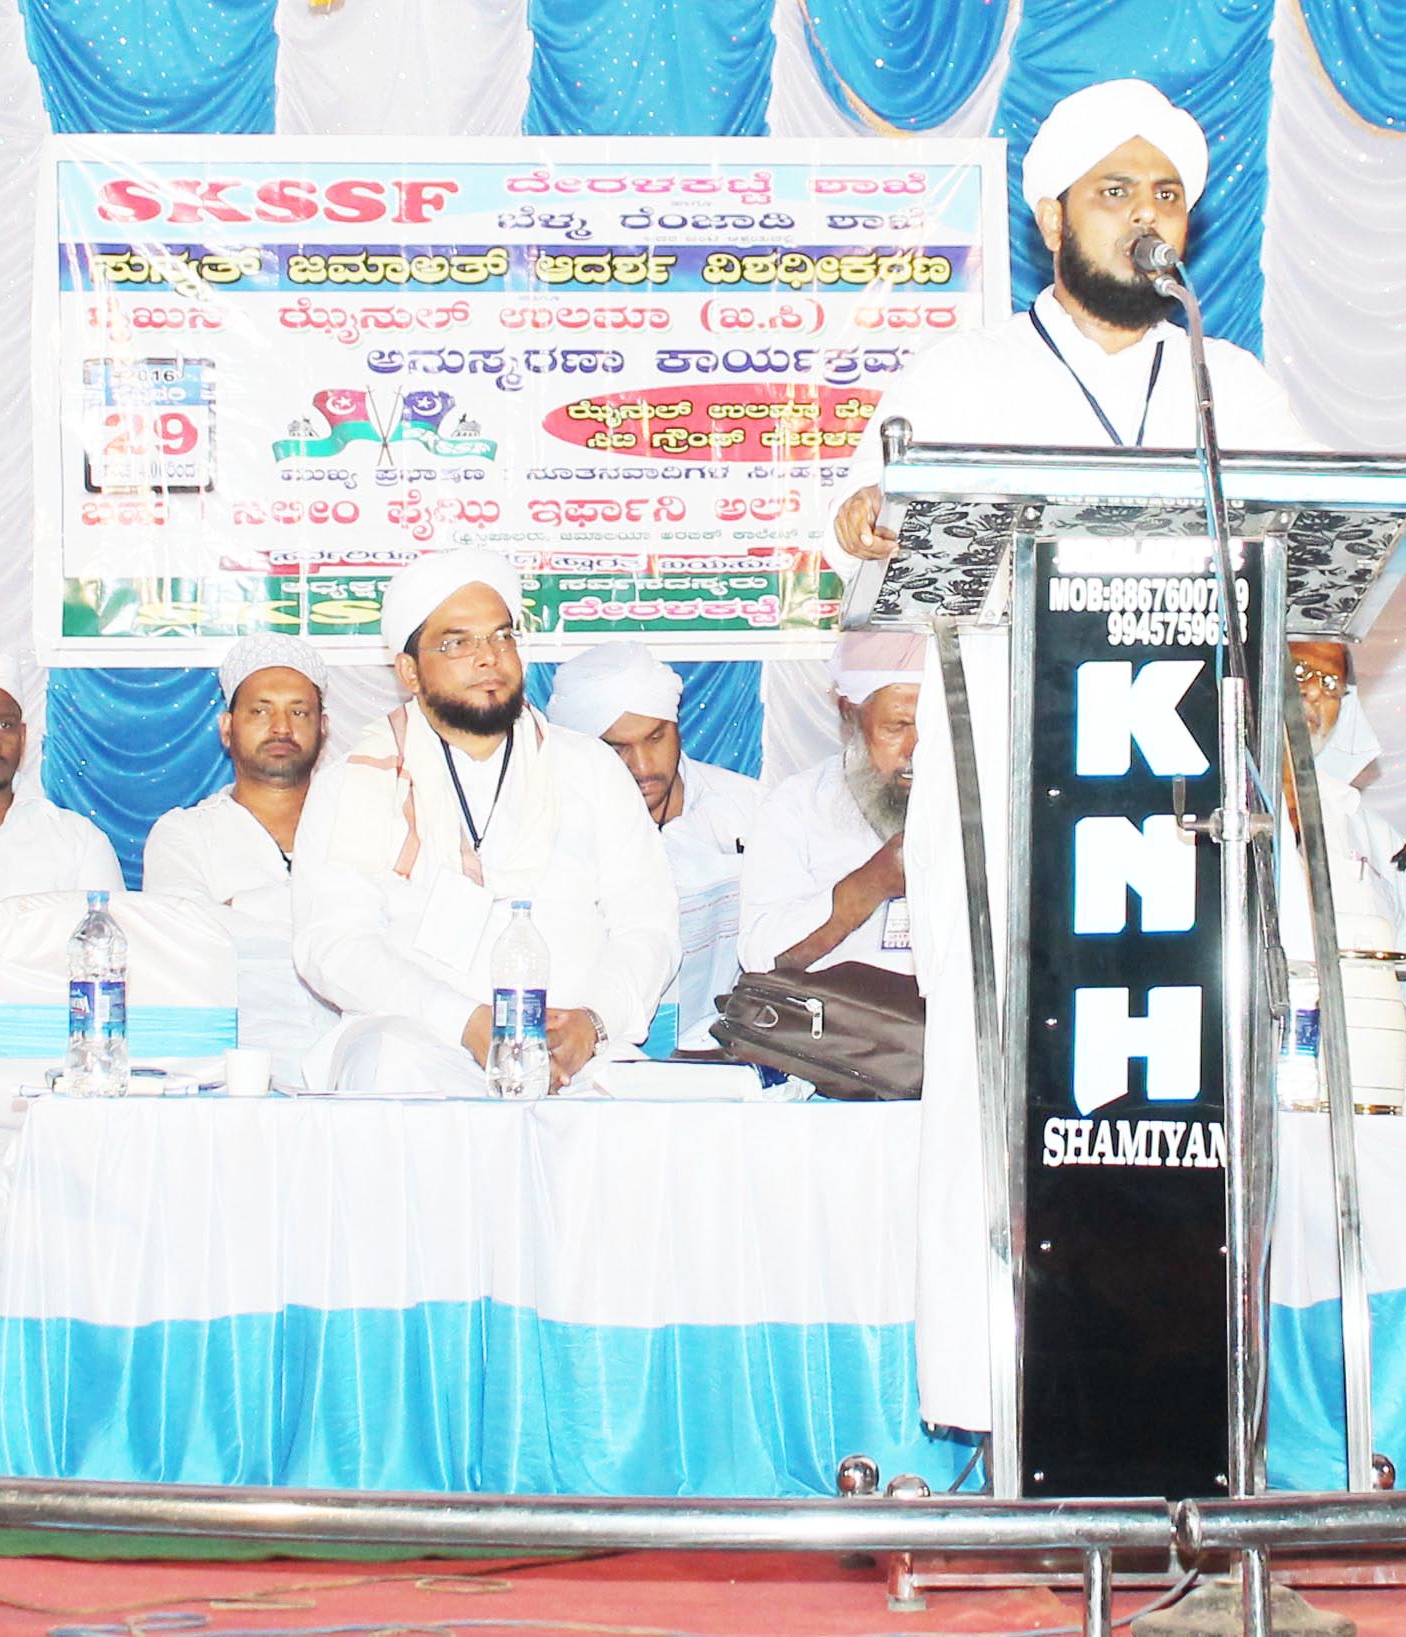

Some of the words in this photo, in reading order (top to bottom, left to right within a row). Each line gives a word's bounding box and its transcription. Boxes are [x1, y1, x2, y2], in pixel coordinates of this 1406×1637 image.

[97, 179, 460, 224] SKSSF
[506, 171, 773, 205] ದೇರಳಕಟ್ಟೆ
[810, 172, 928, 195] ಶಾಖೆ
[826, 208, 927, 231] ಶಾಖೆ
[287, 247, 510, 285] ಜಮಾಅತ್
[534, 249, 678, 285] ಆದರ್ಶ
[499, 303, 670, 329] ಉಲಮಾ
[855, 304, 958, 329] ರವರ
[102, 411, 199, 455] 29
[1049, 577, 1250, 612] MOB:886760079
